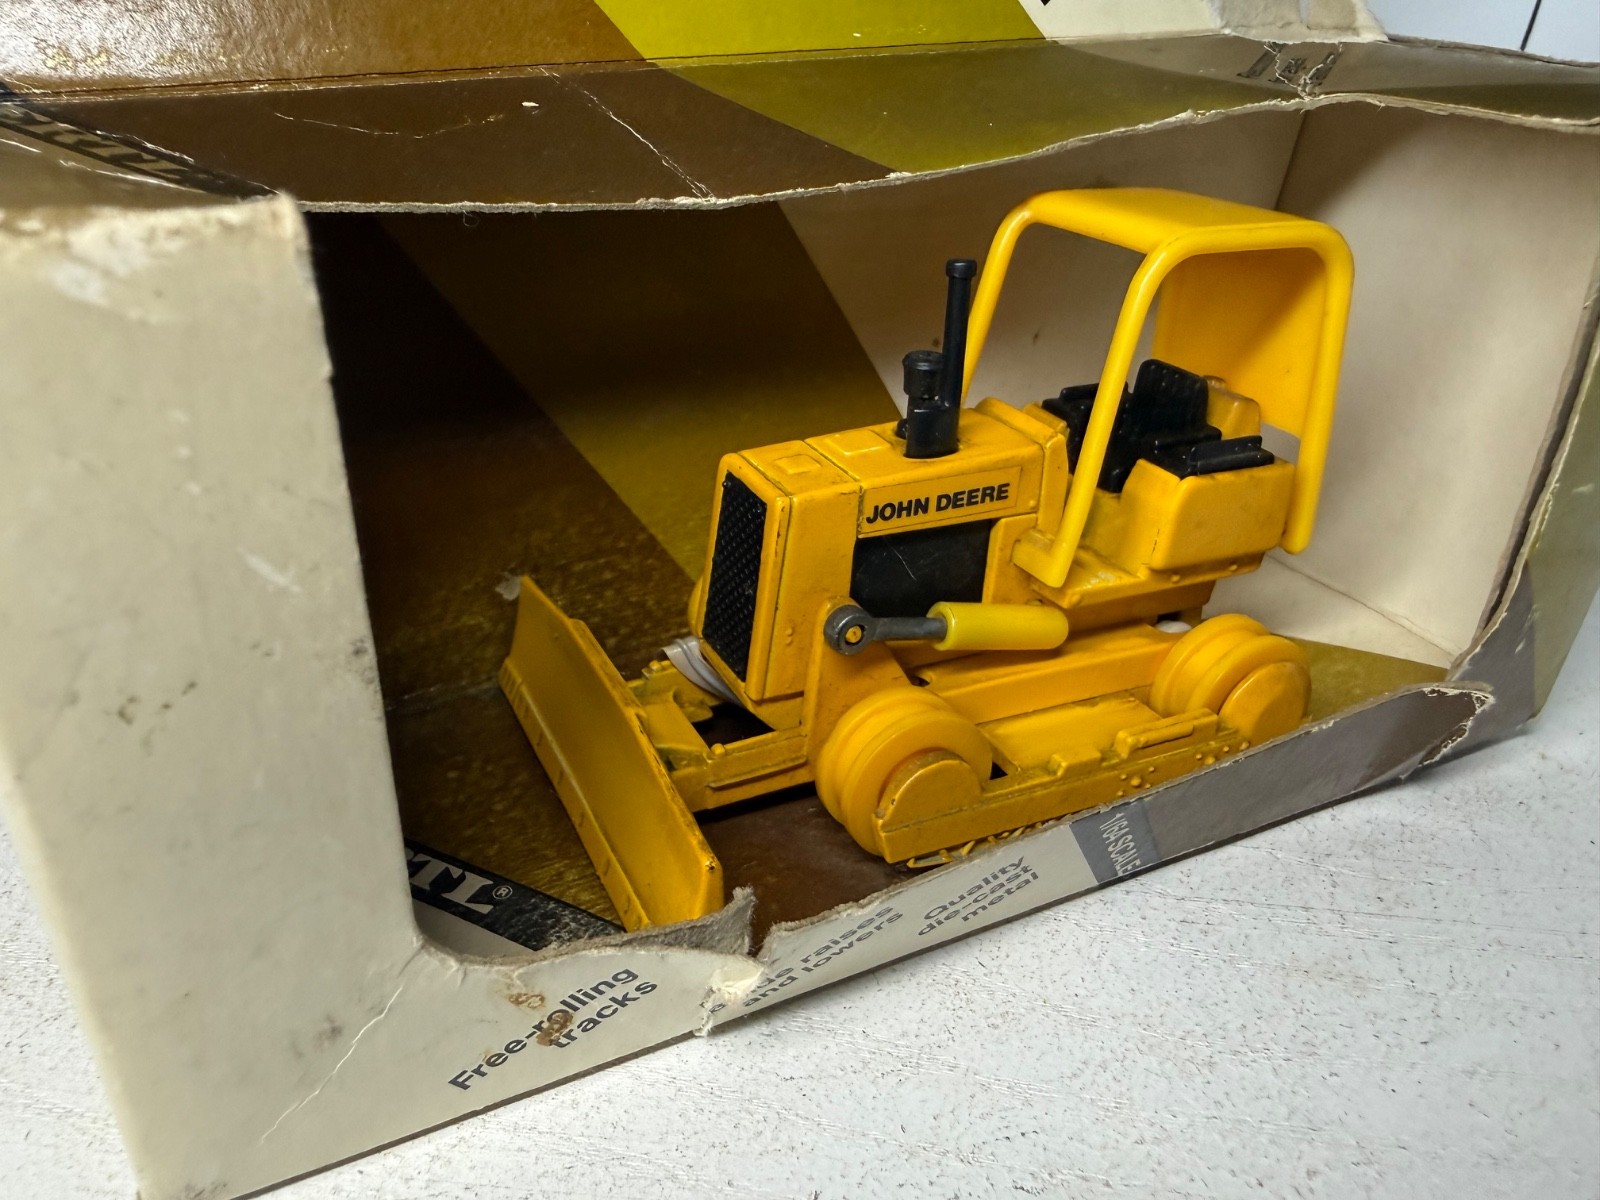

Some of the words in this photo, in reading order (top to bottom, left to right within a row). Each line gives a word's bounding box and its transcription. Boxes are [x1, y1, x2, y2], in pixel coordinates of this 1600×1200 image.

[865, 497, 930, 524] JOHN
[935, 483, 1011, 512] DEERE
[1099, 812, 1130, 844] 1/64
[1107, 834, 1142, 877] SCALE
[918, 865, 1033, 936] die-cast
[923, 856, 1025, 920] Quality
[961, 871, 1039, 922] metal
[742, 975, 799, 1008] and
[801, 912, 904, 973] lowers
[800, 906, 894, 964] raises
[448, 968, 639, 1091] Free-rolling
[551, 981, 658, 1049] tracks
